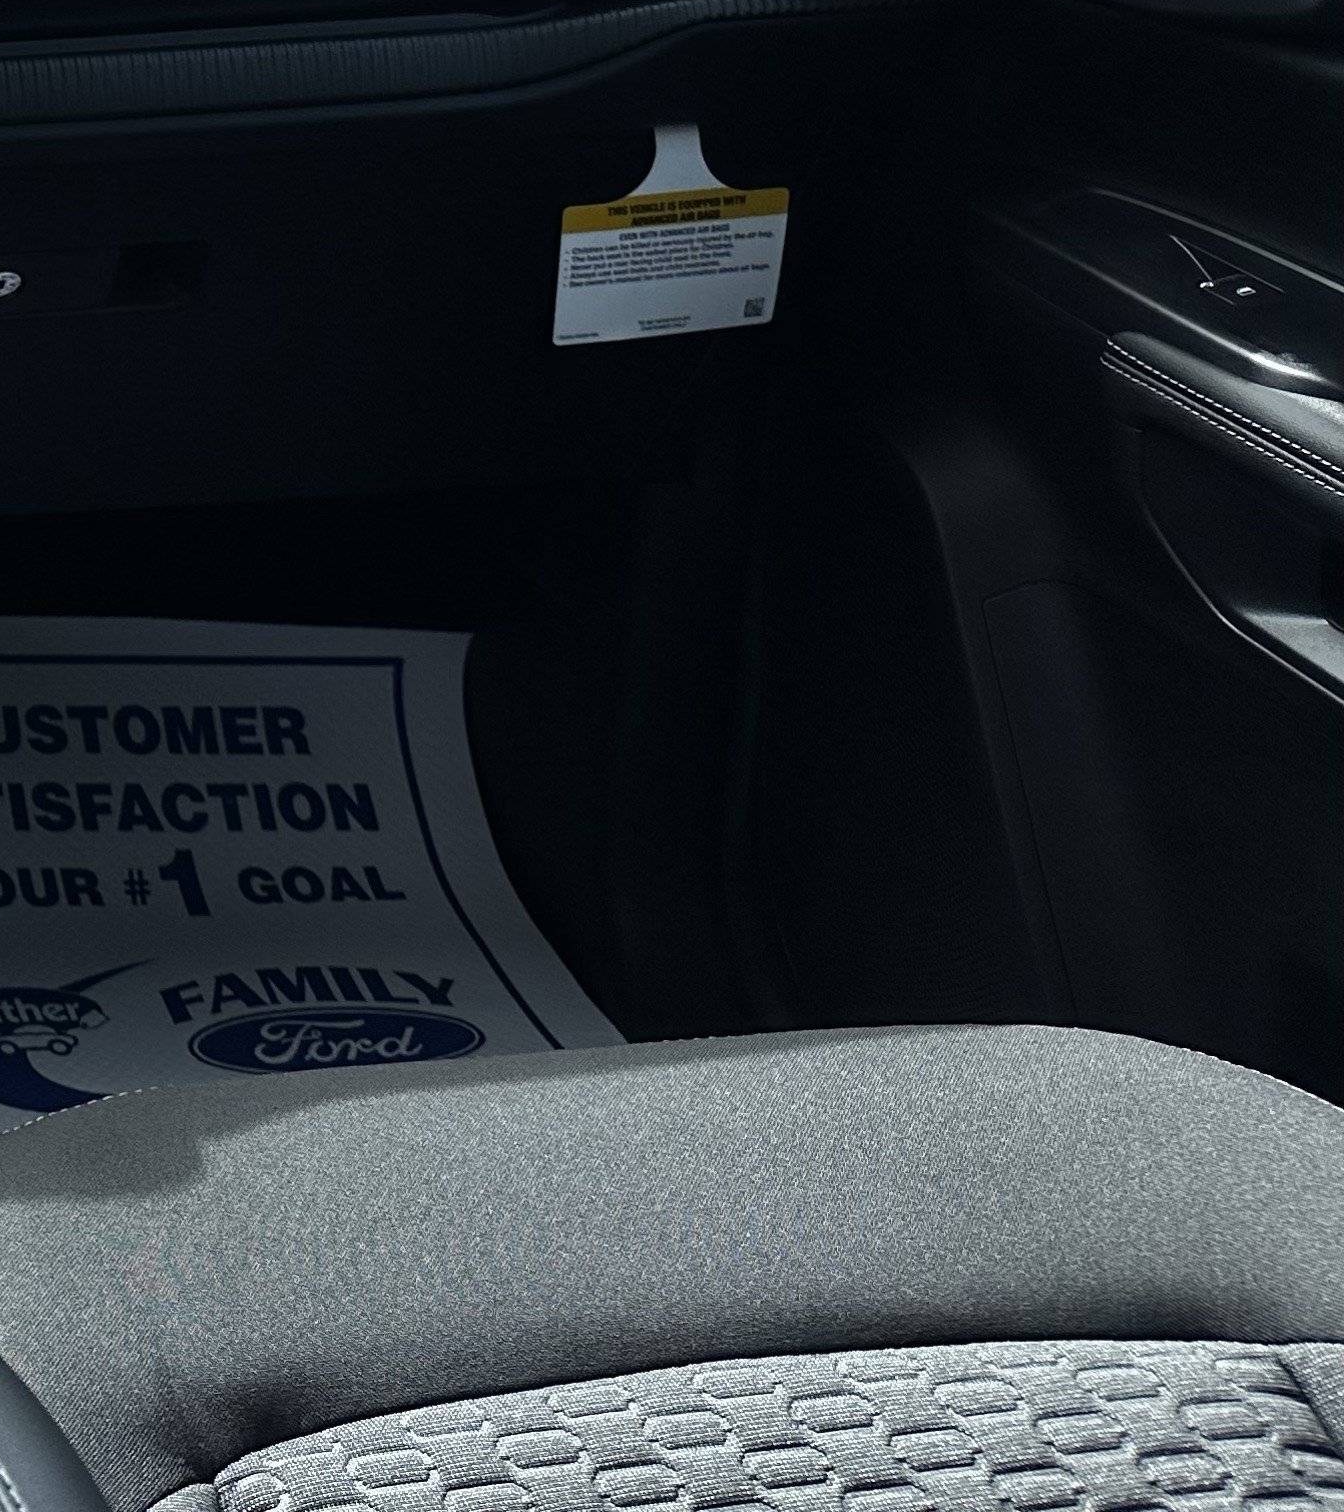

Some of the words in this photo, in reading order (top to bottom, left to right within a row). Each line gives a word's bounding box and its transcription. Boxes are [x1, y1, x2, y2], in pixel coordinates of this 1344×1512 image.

[123, 847, 212, 918] #1
[236, 863, 408, 906] GOAL
[158, 964, 462, 1026] FAMILY
[253, 1017, 426, 1066] Ford
